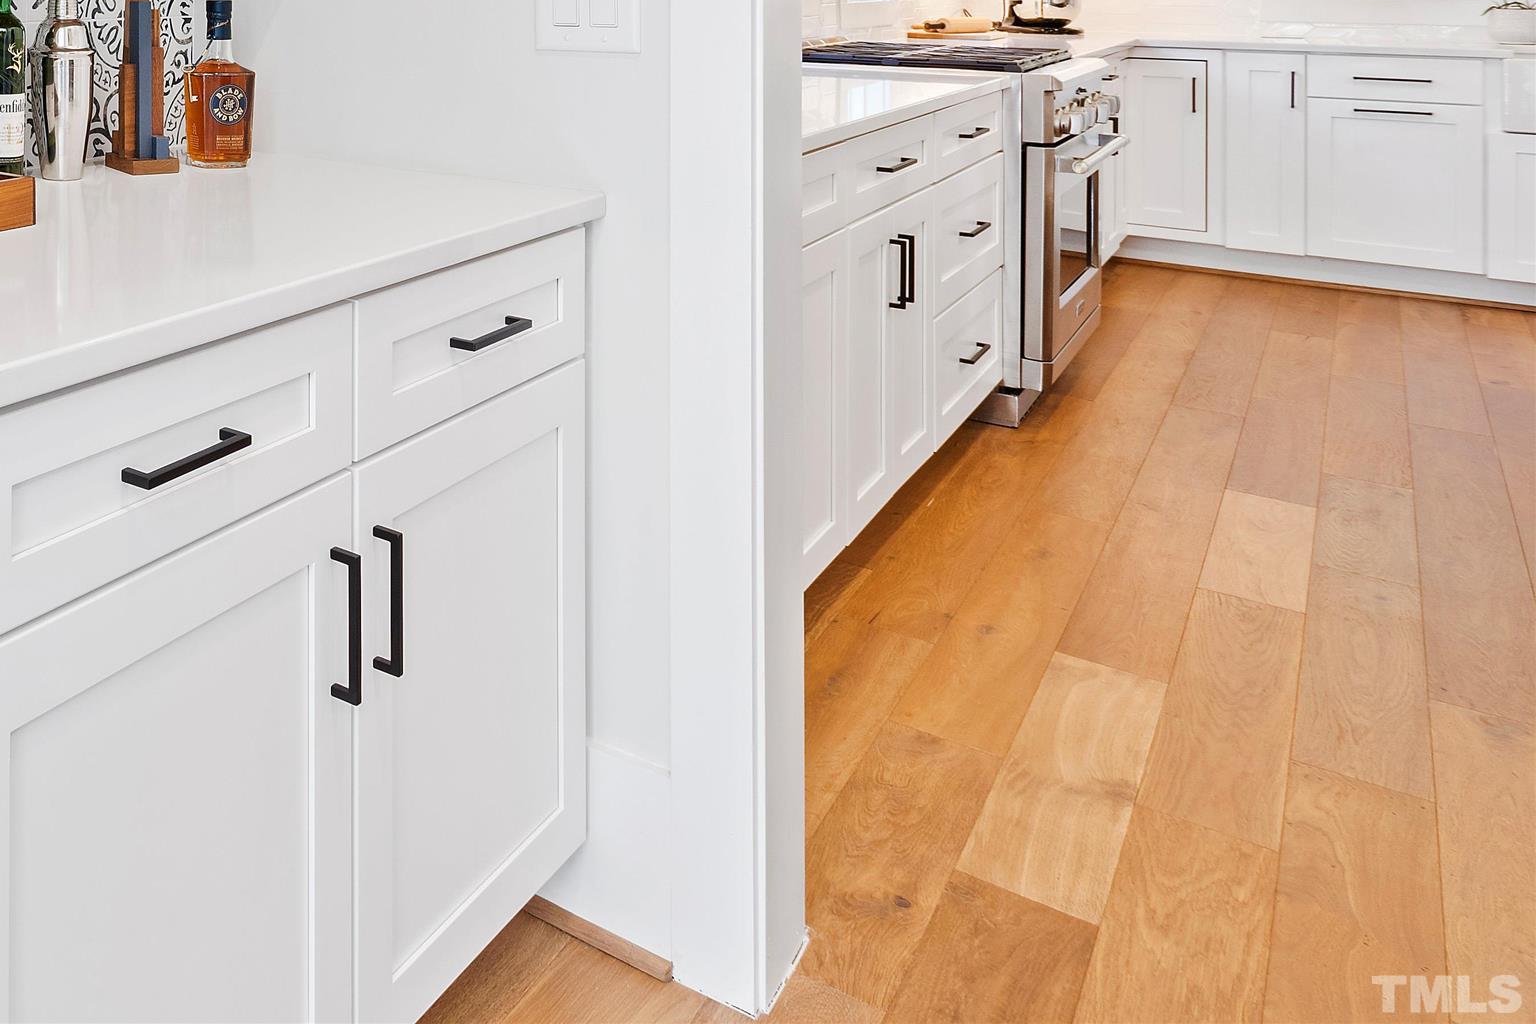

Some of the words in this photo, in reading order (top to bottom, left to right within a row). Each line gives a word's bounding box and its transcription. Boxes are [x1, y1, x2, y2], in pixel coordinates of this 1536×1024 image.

[215, 87, 244, 100] BLADE
[213, 107, 228, 122] AND
[228, 107, 244, 122] BOW
